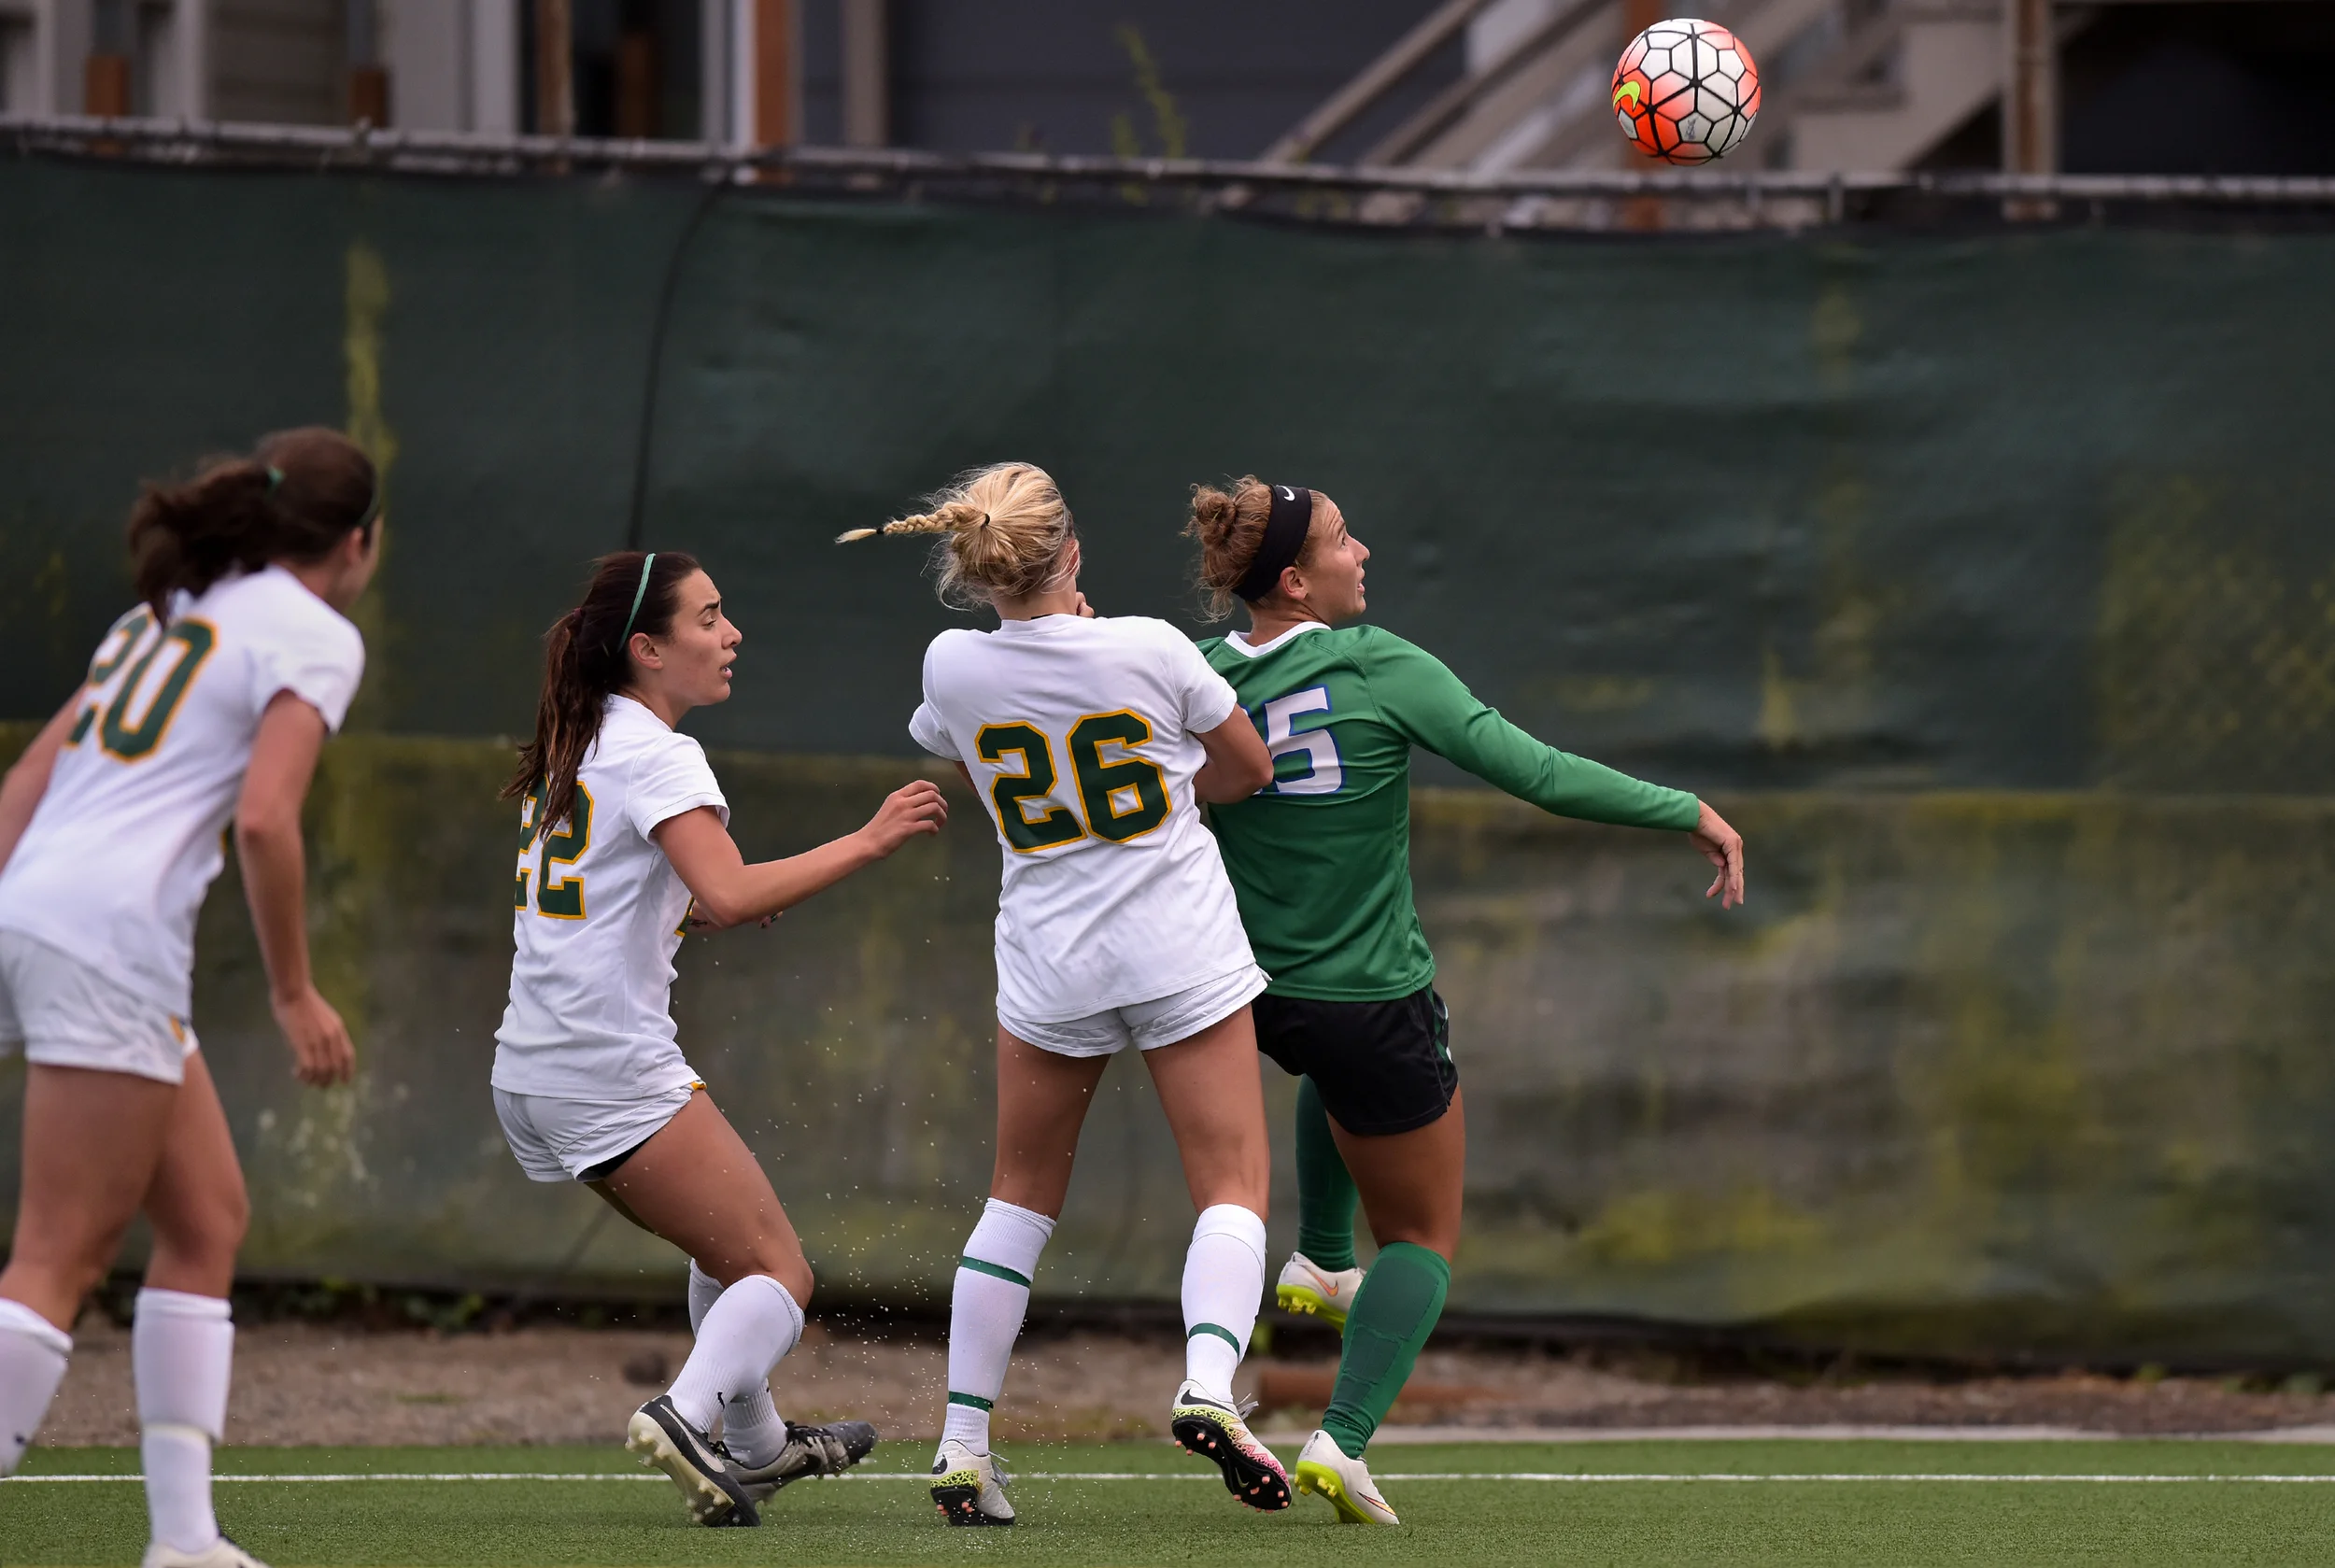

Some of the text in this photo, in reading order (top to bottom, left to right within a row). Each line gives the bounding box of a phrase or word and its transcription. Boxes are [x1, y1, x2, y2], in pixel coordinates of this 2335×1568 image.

[65, 607, 219, 765] 20
[1241, 685, 1347, 795] 5
[515, 772, 594, 920] 22
[974, 708, 1172, 854] 26
